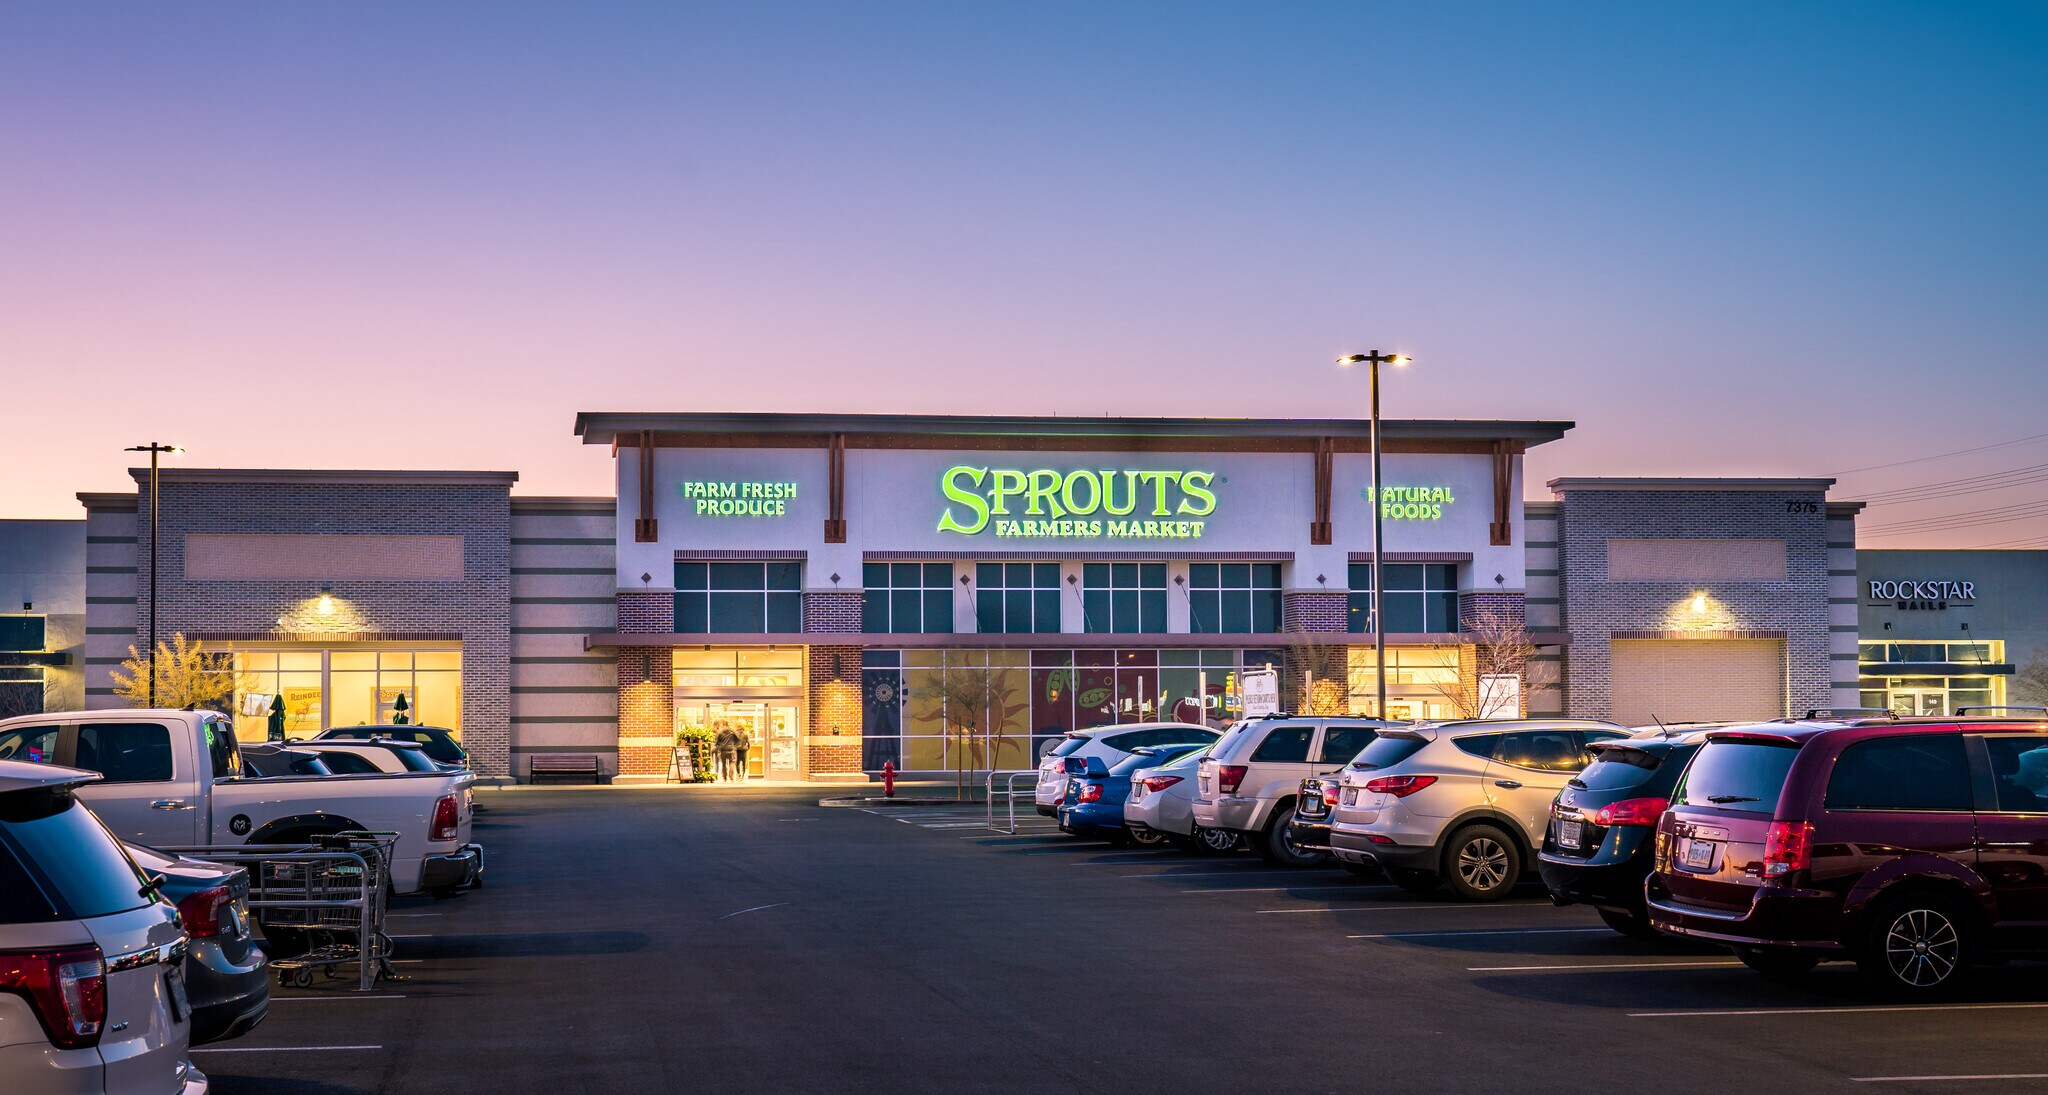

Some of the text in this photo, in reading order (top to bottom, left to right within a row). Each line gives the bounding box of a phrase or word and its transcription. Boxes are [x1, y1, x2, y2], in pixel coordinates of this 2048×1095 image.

[684, 482, 797, 498] FARM FRESH
[696, 499, 786, 515] PRODUCE
[937, 465, 1217, 534] SPROUTS
[1785, 501, 1818, 513] 7375
[1382, 503, 1441, 519] FOODS
[995, 520, 1205, 537] FARMERS MARKET
[1868, 580, 1976, 599] ROCKSTAR
[1897, 601, 1947, 610] NAILS
[290, 691, 321, 701] REINDEE
